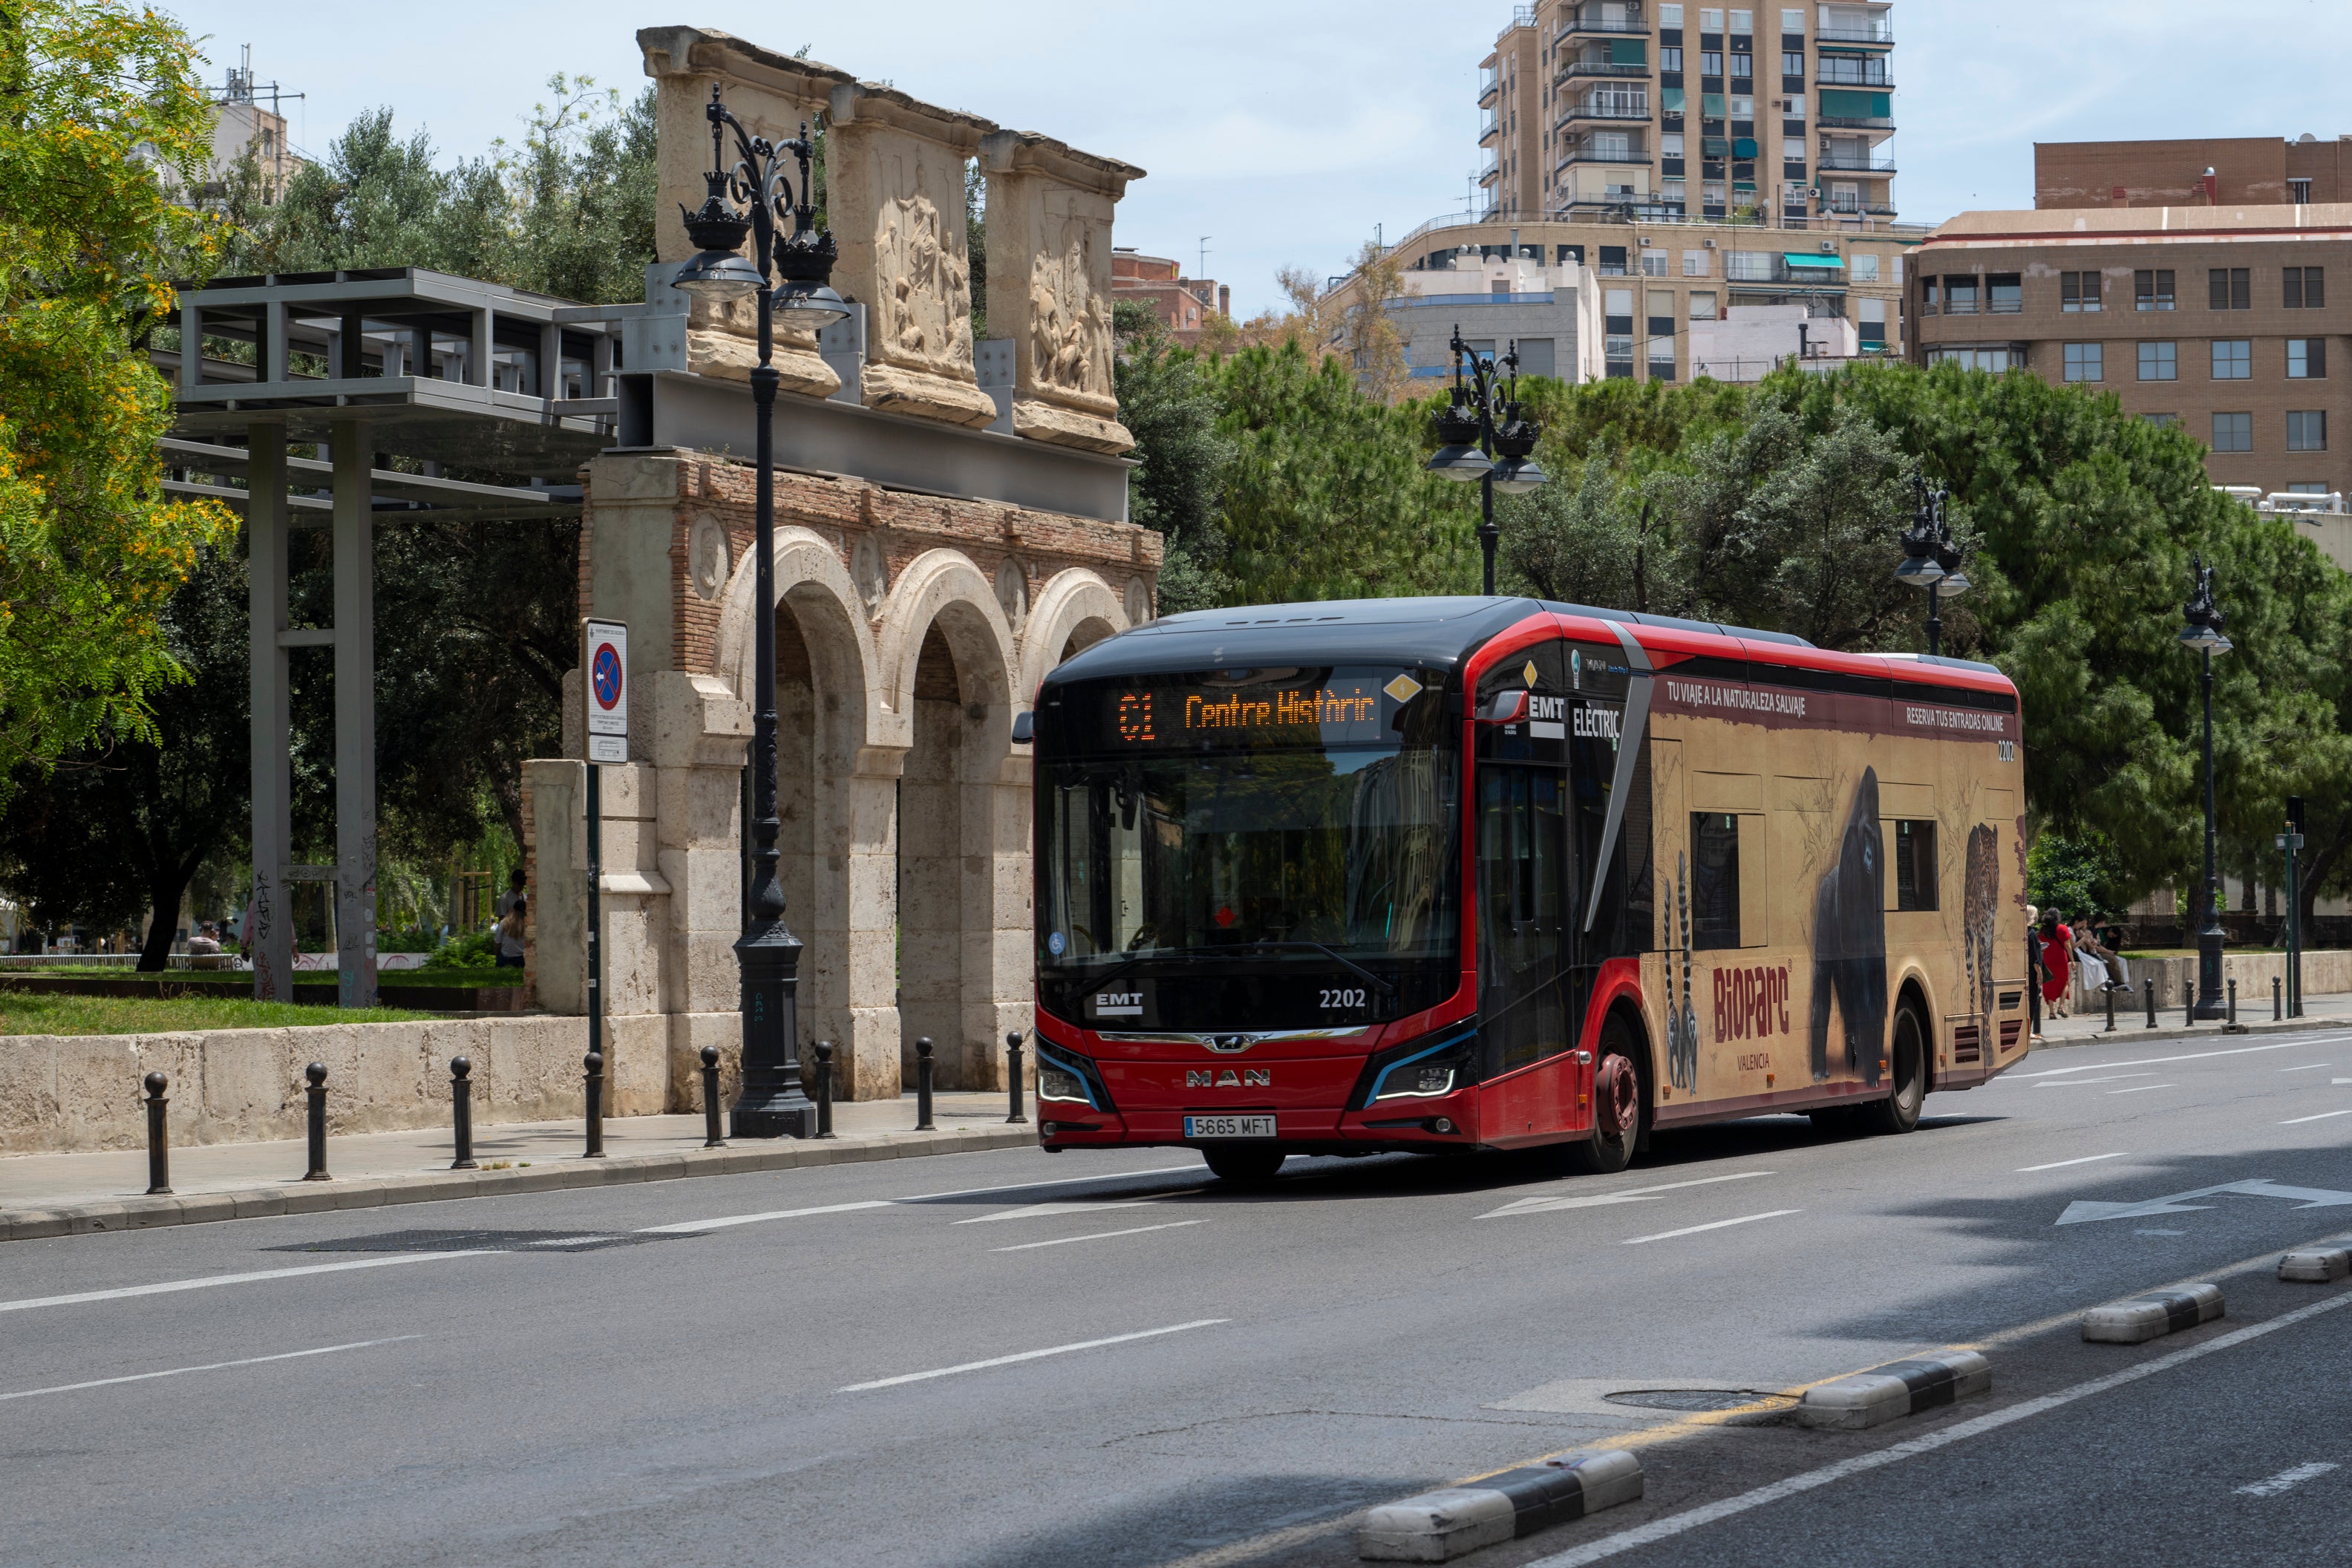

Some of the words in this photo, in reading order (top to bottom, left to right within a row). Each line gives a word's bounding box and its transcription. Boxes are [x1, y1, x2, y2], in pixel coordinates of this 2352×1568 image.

[1586, 659, 1606, 671] MAN
[1186, 694, 1270, 728] Centre
[1278, 689, 1374, 725] Històric
[1529, 696, 1564, 719] EMT
[1667, 681, 1679, 701] TU
[1680, 682, 1702, 708] VIAJE
[1704, 686, 1711, 705] A
[1711, 687, 1722, 706] LA
[1723, 688, 1775, 711] NATURALEZA
[1776, 693, 1806, 719] SALVAJE
[1573, 700, 1620, 738] ELÈCTRIC
[1907, 707, 1936, 726] RESERVA
[1936, 710, 1948, 727] TUS
[1949, 711, 1981, 731] ENTRADAS
[1982, 714, 2004, 732] ONLINE
[1998, 739, 2014, 762] 2202
[1096, 993, 1143, 1005] EMT
[1319, 989, 1365, 1008] 2202
[1737, 1053, 1770, 1071] VALENCIA
[1186, 1069, 1270, 1087] MAN
[1195, 1119, 1236, 1135] 5665
[1241, 1118, 1272, 1135] MFT
